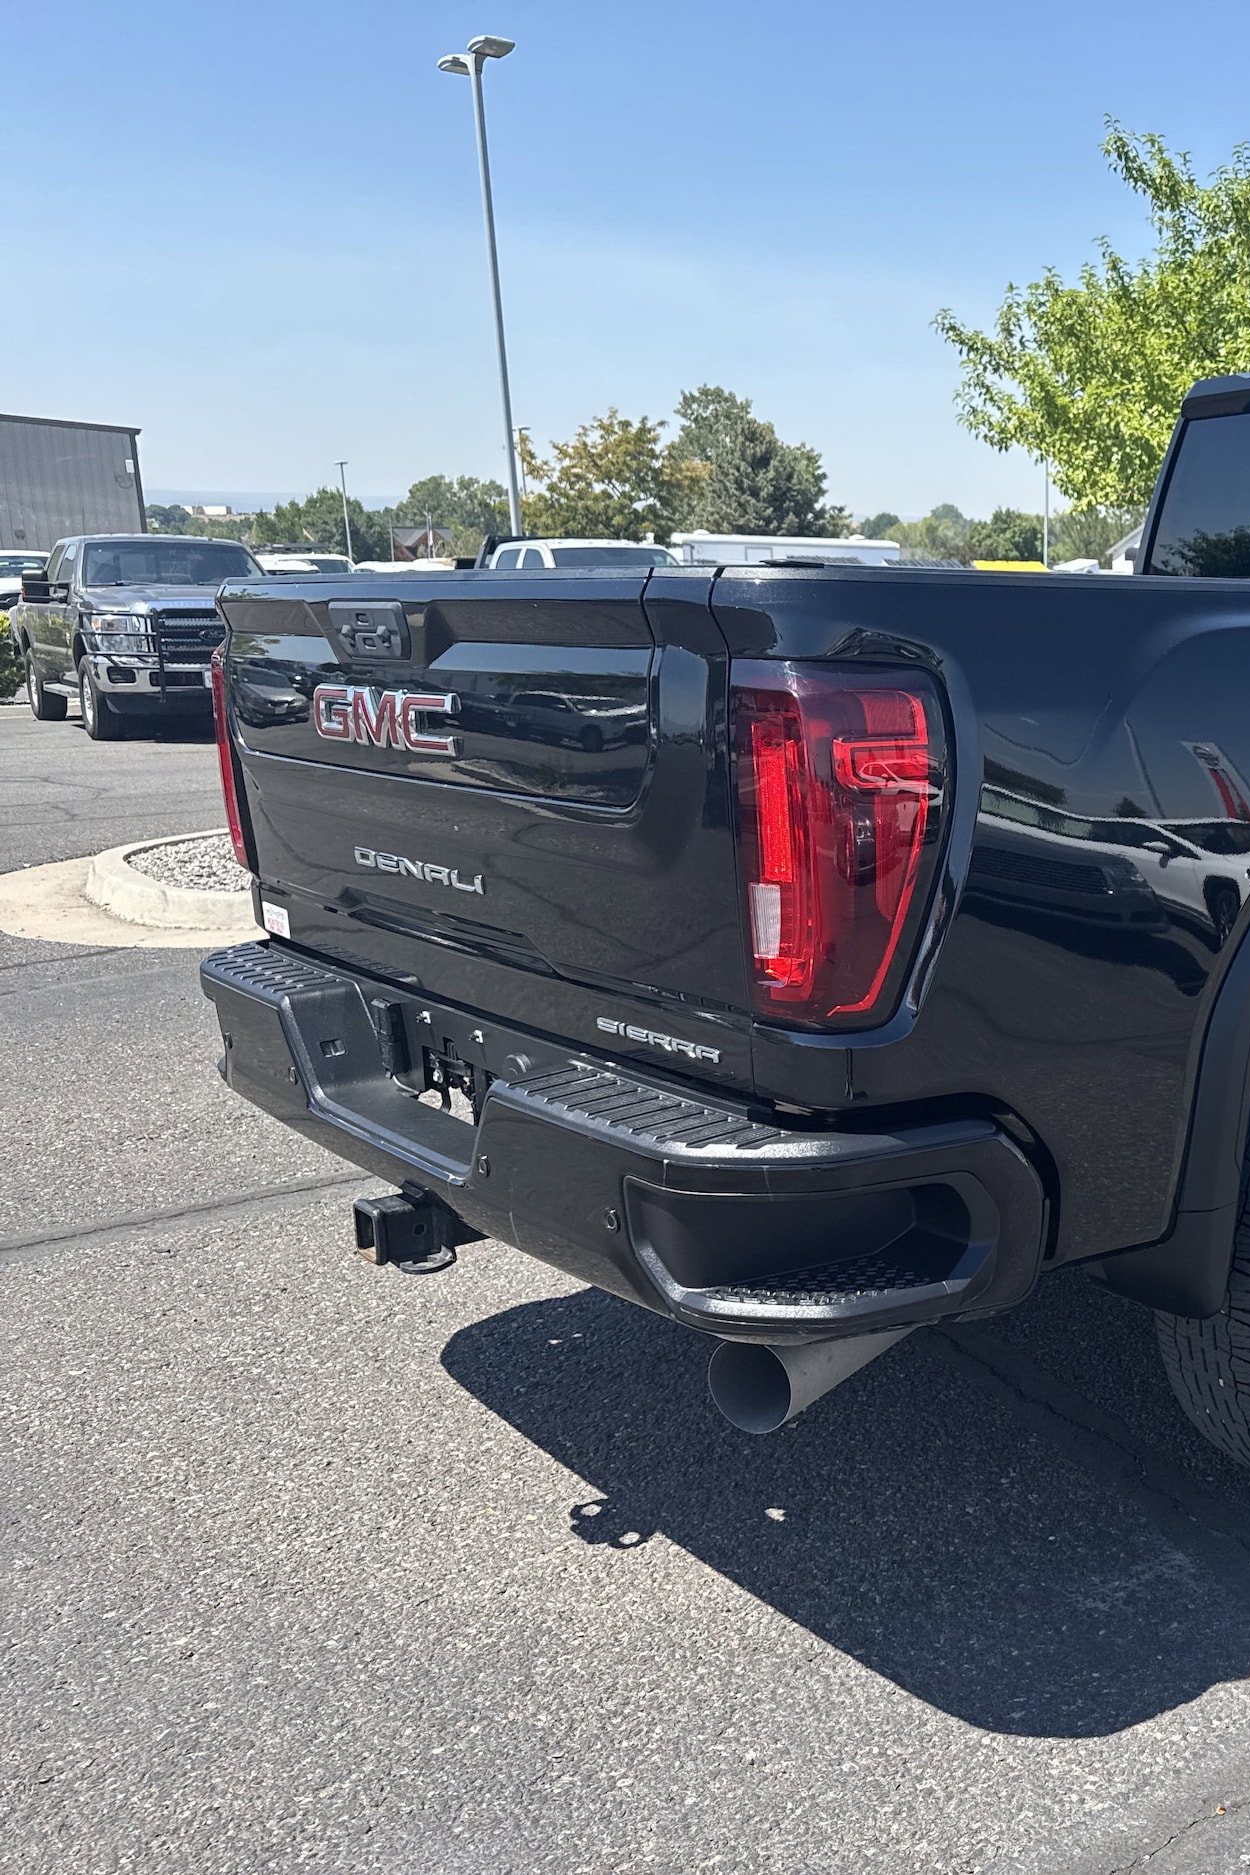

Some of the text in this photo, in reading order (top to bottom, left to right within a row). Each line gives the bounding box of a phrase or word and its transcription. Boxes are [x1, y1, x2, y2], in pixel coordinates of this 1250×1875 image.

[314, 683, 461, 757] GMC
[354, 846, 484, 895] DENALI
[597, 1017, 720, 1063] SIERRA
